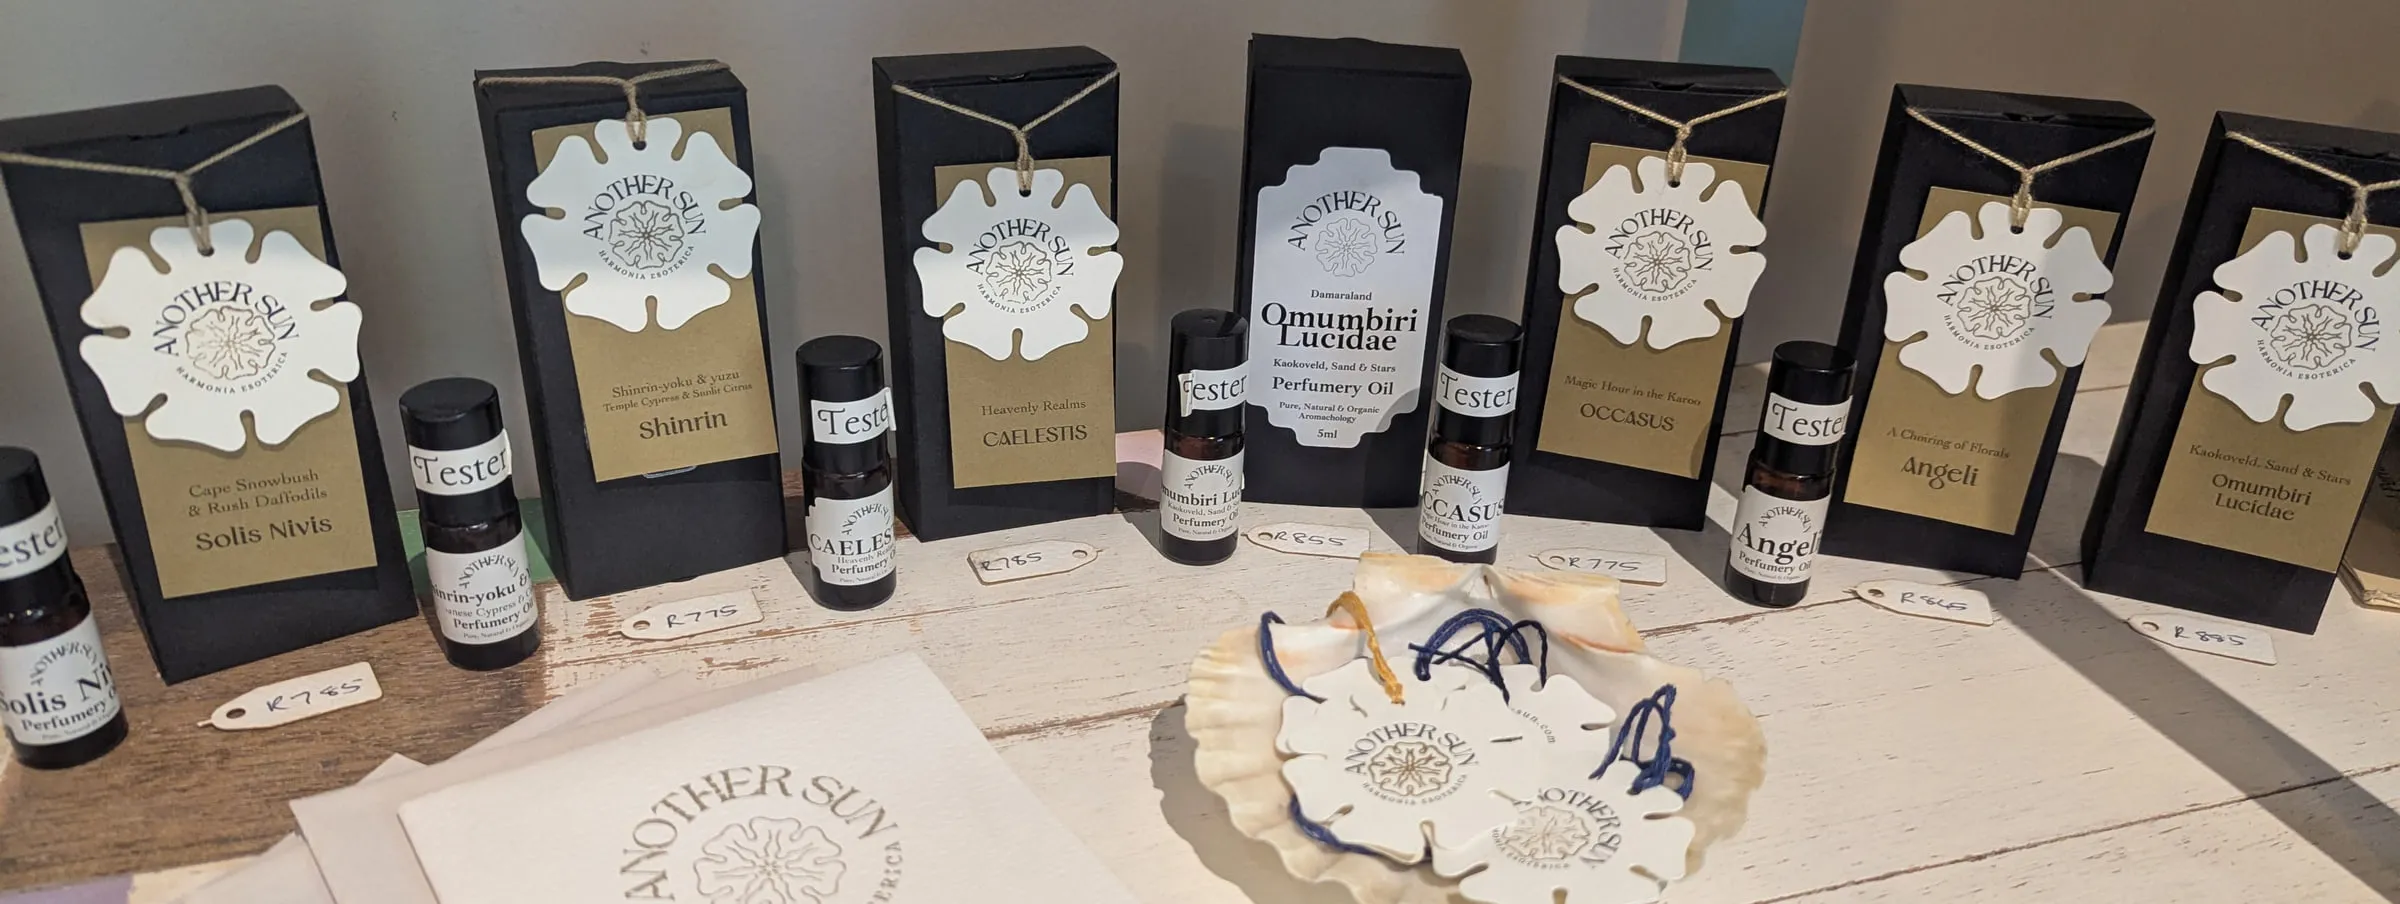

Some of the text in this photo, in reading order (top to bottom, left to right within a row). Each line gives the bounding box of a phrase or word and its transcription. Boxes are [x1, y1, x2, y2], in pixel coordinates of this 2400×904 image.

[583, 174, 706, 240] ANOTHER SUN
[1287, 190, 1405, 254] ANOTHER SUN
[966, 218, 1074, 277] ANOTHER SUN
[1604, 208, 1714, 271] ANOTHER SUN
[598, 245, 695, 280] HARMONIA ESOTERICA
[976, 282, 1062, 314] HARMONIA ESOTERICA
[1310, 289, 1372, 301] Damaraland
[1612, 267, 1698, 302] HARMONIA ESOTERICA
[1936, 254, 2055, 319] ANOTHER SUN
[153, 280, 300, 357] ANOTHER SUN
[1261, 302, 1418, 332] Omumbiri
[2251, 279, 2381, 352] ANOTHER SUN
[1277, 323, 1397, 351] Lucidae
[1943, 314, 2036, 350] HARMONIA ESOTERICA
[176, 350, 289, 394] HARMONIA ESOTERICA
[1273, 358, 1396, 373] Kaokoveld, Sand & Stars
[2256, 338, 2357, 380] HARMONIA ESOTERICA
[603, 399, 638, 412] Temple
[641, 395, 680, 407] Cypress
[682, 391, 690, 400] &
[724, 383, 753, 393] Citrus
[612, 371, 740, 398] Shinrin-yoku & yuzu
[1272, 376, 1394, 398] Perfumery Oil
[1440, 371, 1515, 409] Tester
[1564, 375, 1701, 406] Magic Hour in the Karoo
[817, 402, 888, 436] Teste
[982, 399, 1086, 416] Heavenly Realms
[1279, 401, 1380, 415] Pure, Natural & Organic
[1298, 412, 1357, 424] Aromachology
[1580, 402, 1674, 431] OCCASUS
[639, 411, 728, 440] Shinrin
[983, 424, 1087, 447] CAELESTIS
[1317, 428, 1337, 439] 5ml
[1887, 426, 1897, 437] A
[1954, 440, 1968, 450] of
[1970, 441, 2010, 459] Florals
[413, 446, 508, 487] Tester
[1901, 456, 1979, 490] Angeli
[2264, 458, 2299, 475] Sand
[2302, 466, 2315, 478] &
[2317, 469, 2351, 486] Stars
[189, 468, 319, 501] Cape Snowbush
[1162, 486, 1217, 506] mumbiri
[2212, 472, 2312, 506] Omumbiri
[188, 488, 327, 517] & Rush Daffodils
[1423, 491, 1504, 523] CCASUS
[2215, 492, 2295, 521] Lucidae
[196, 515, 332, 551] Solis Nivis
[1173, 513, 1226, 527] Perfumery
[1473, 530, 1488, 541] Oil
[0, 517, 63, 567] ester
[810, 528, 892, 556] CAELES
[832, 559, 888, 574] Perfumery
[981, 552, 1042, 571] R785
[1569, 557, 1642, 571] R775
[1739, 551, 1795, 575] Perfumery
[453, 611, 520, 630] Perfumery
[476, 602, 517, 618] Cypress
[667, 605, 737, 628] R775
[266, 678, 362, 712] R785
[21, 700, 106, 731] Perfumery
[1344, 722, 1479, 776] ANOTHER SUN
[620, 765, 898, 901] ANOTHER SUN
[868, 841, 903, 904] ERICA
